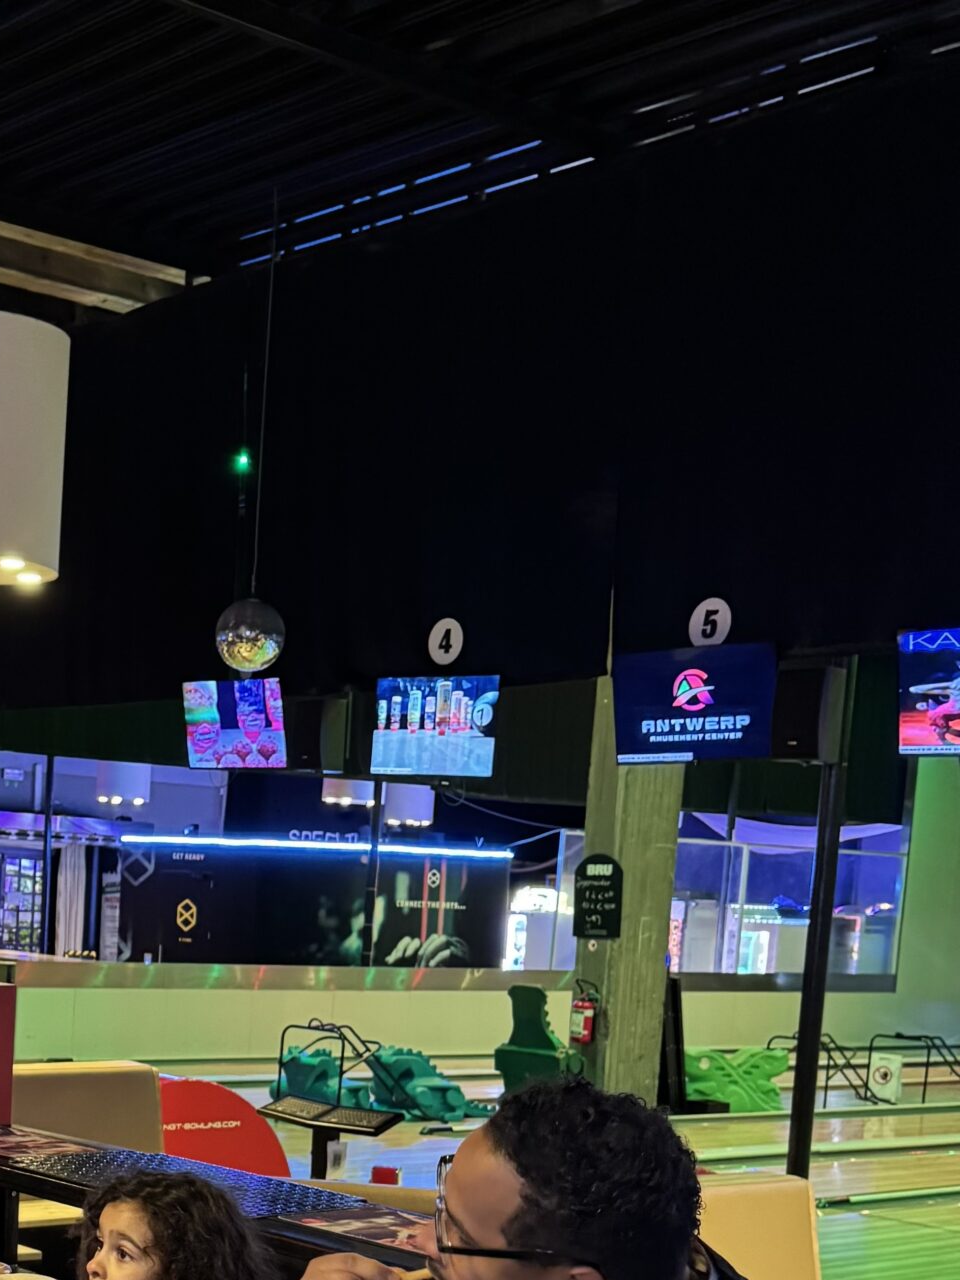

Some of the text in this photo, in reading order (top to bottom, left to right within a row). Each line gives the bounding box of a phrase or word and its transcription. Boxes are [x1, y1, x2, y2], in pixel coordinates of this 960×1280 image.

[701, 609, 719, 639] 5
[438, 628, 452, 654] 4
[641, 714, 751, 734] ANTWERP
[649, 732, 743, 743] AMUSEMENT CENTER
[172, 852, 205, 861] GET READY
[586, 863, 613, 877] BRU
